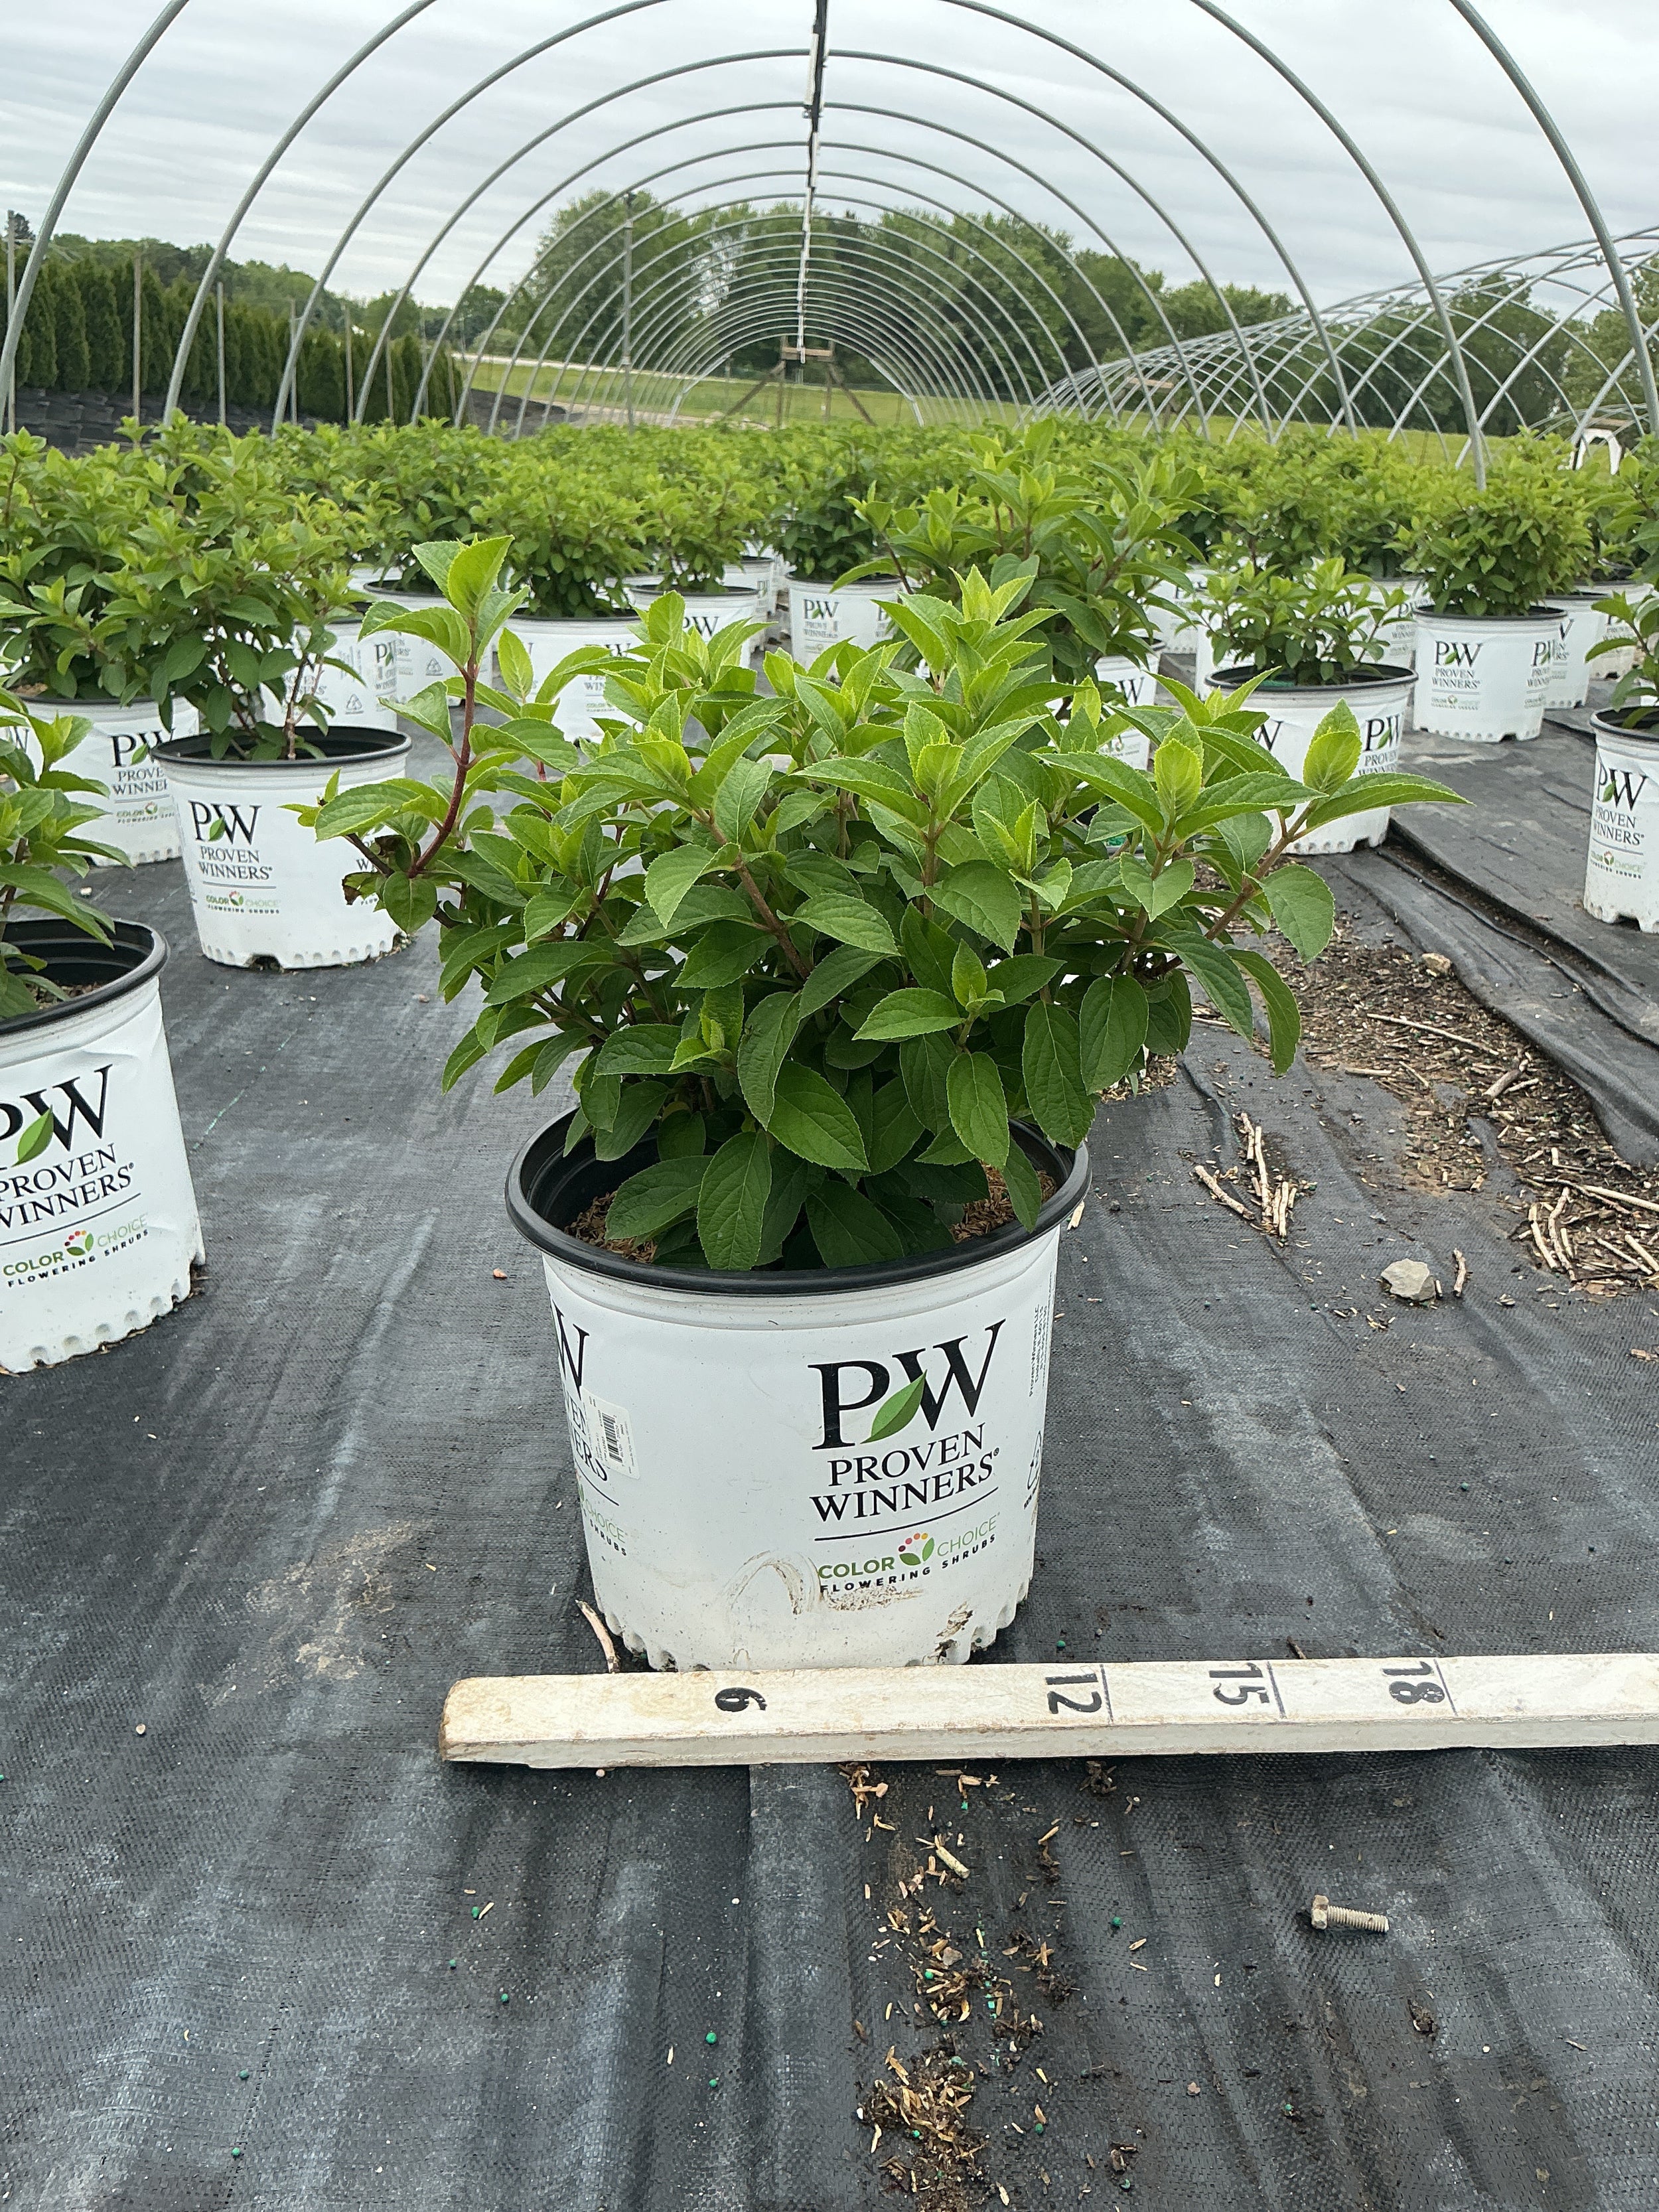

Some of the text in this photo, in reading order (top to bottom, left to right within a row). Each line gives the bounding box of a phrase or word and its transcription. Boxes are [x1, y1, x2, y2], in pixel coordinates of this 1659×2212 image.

[803, 599, 839, 620] PW
[1434, 640, 1484, 667] PW
[1435, 667, 1475, 678] PROVEN
[112, 779, 167, 795] WINNE
[117, 767, 165, 782] PROVE
[1596, 763, 1649, 812] PW
[188, 800, 263, 846] PW
[1596, 805, 1636, 828] PROVEN
[200, 846, 260, 863] PROVEN
[3, 1213, 148, 1276] COLOR CHOICE
[8, 1228, 149, 1288] FLOWERING SHRUBS
[552, 1299, 590, 1401] W
[807, 1318, 1006, 1450] PW
[828, 1422, 985, 1487] PROVEN
[818, 1513, 997, 1580] COLOR CHOICE
[820, 1534, 996, 1593] FLOWERING SHRUBS
[715, 1687, 767, 1712] 6
[1045, 1672, 1102, 1715] 12
[1209, 1662, 1270, 1705] 15
[1382, 1660, 1445, 1705] 18
